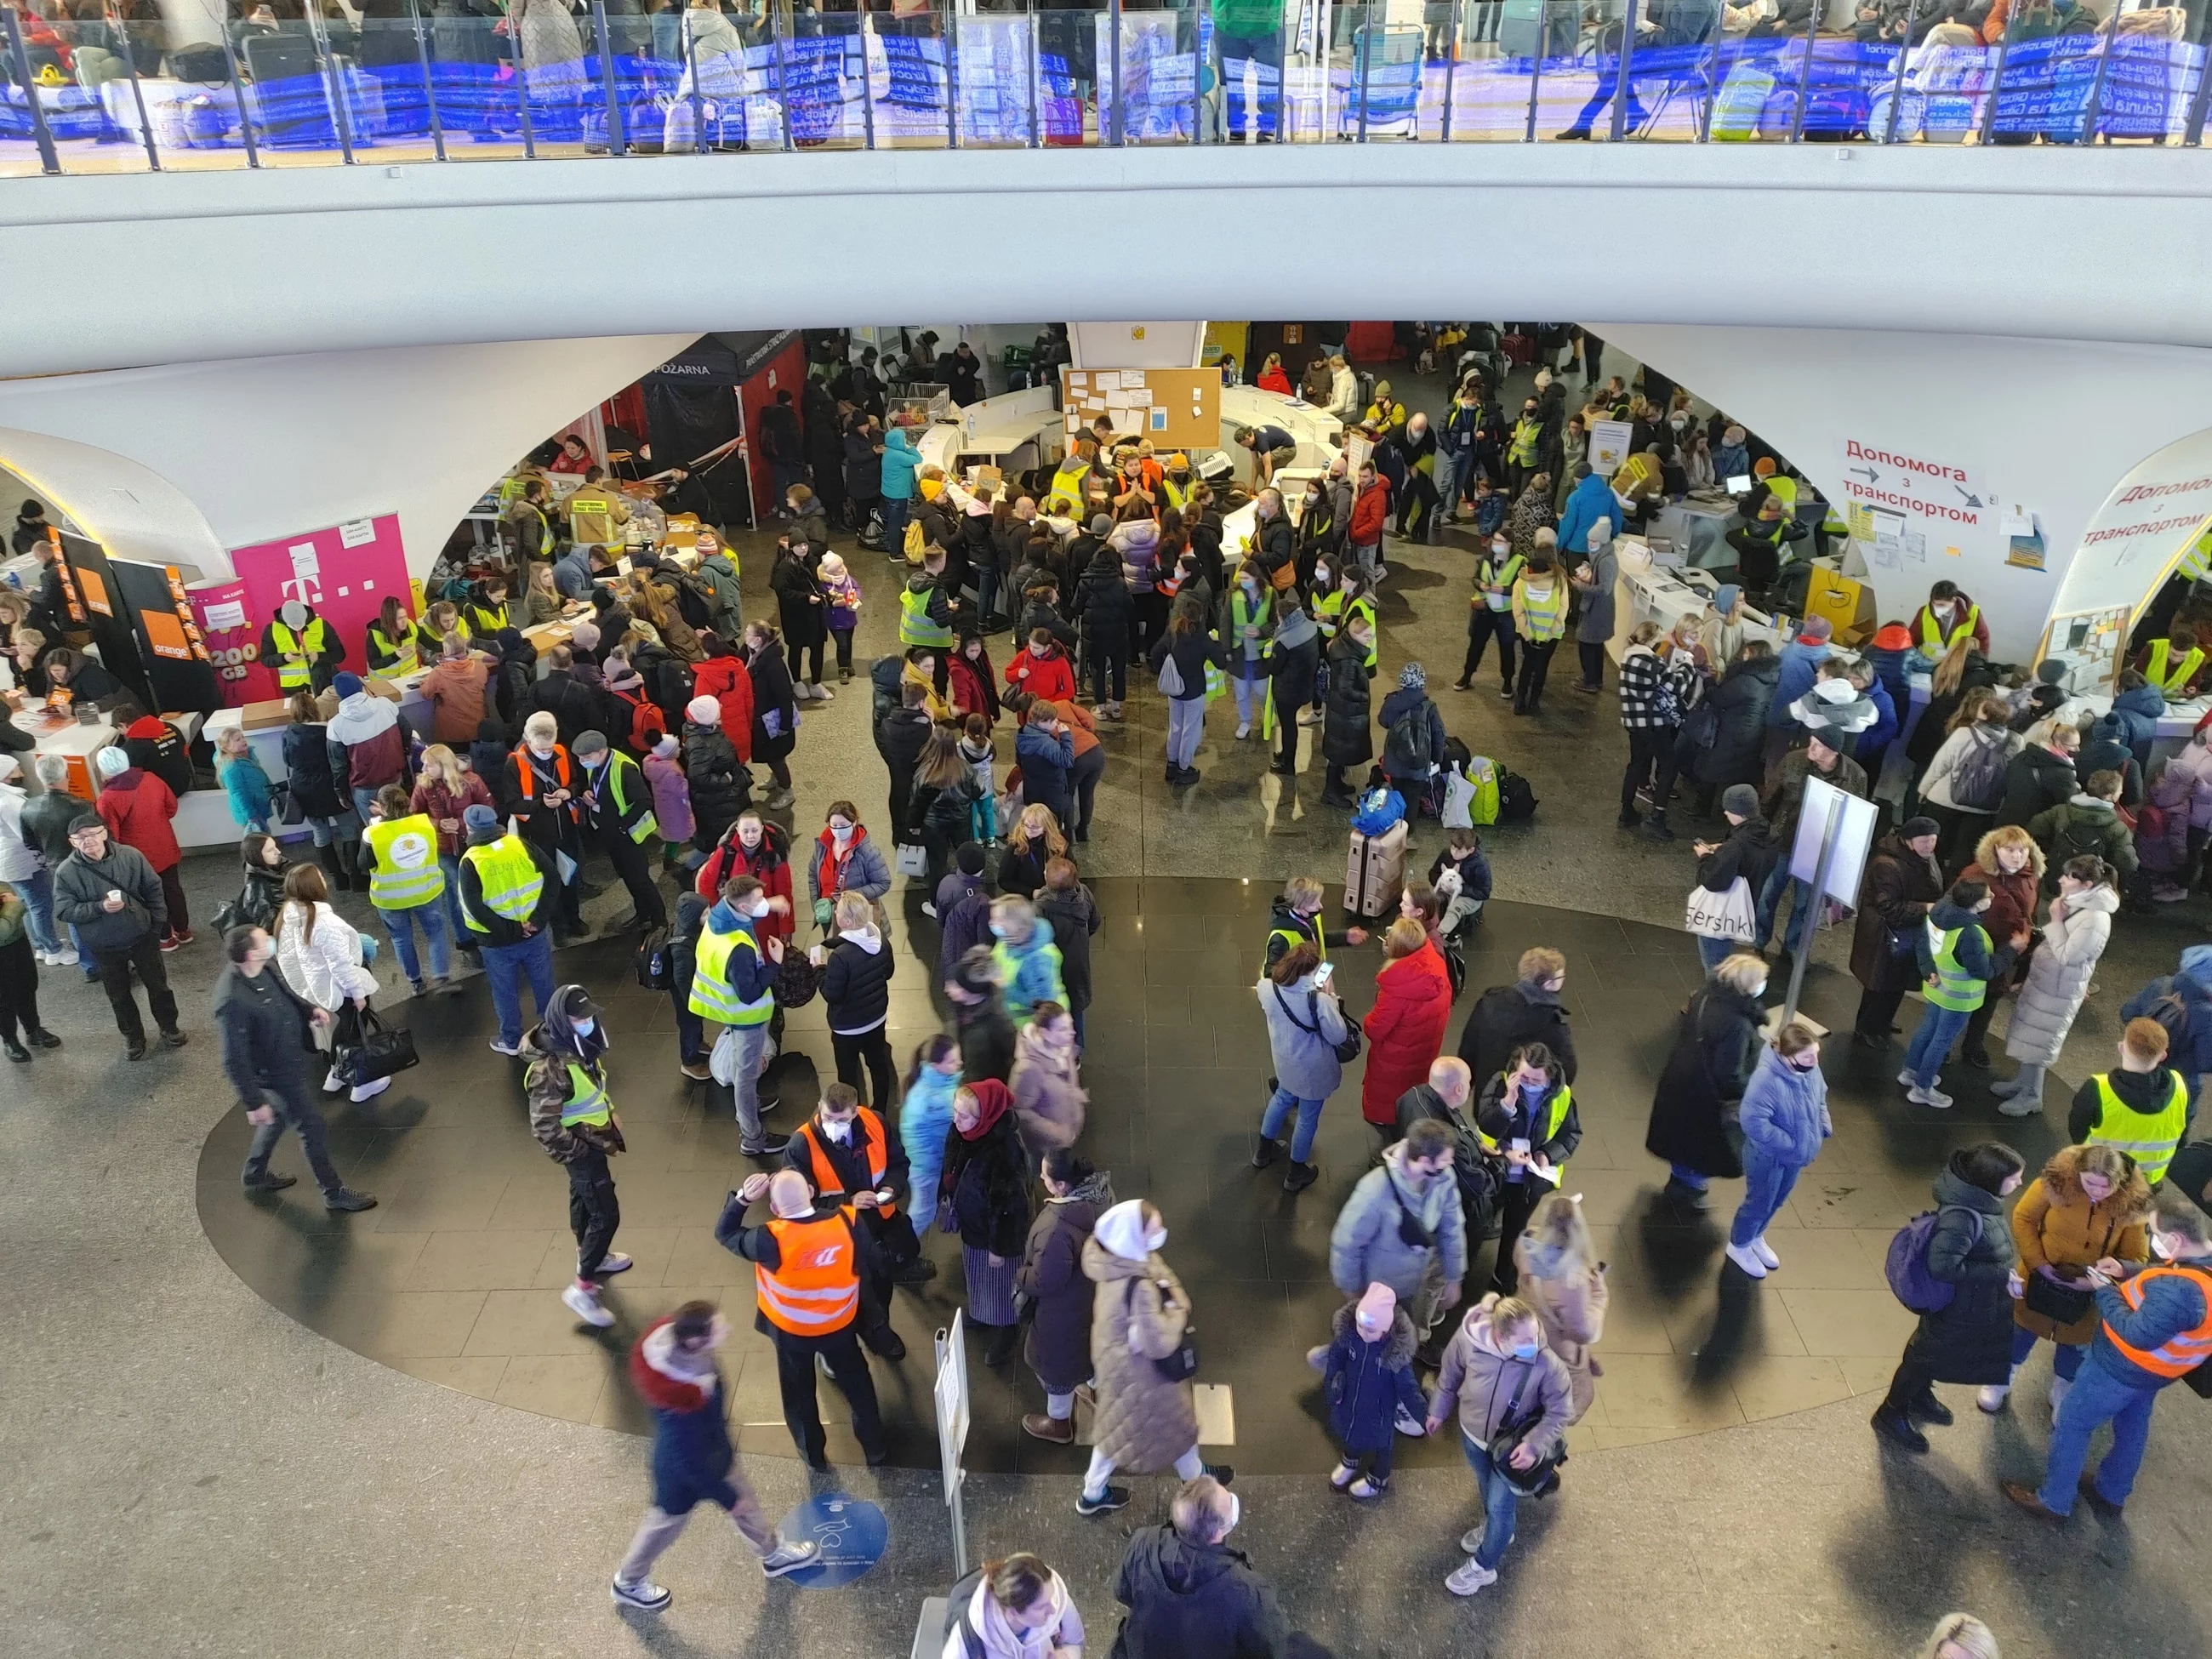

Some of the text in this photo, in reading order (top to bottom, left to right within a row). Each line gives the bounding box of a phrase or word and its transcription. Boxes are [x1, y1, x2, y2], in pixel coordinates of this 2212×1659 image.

[1846, 439, 1967, 482] Допомога
[1843, 479, 1978, 525] транспортом
[2084, 514, 2206, 545] транспортом
[154, 644, 188, 658] orange
[211, 643, 258, 668] 200
[220, 665, 248, 681] GB
